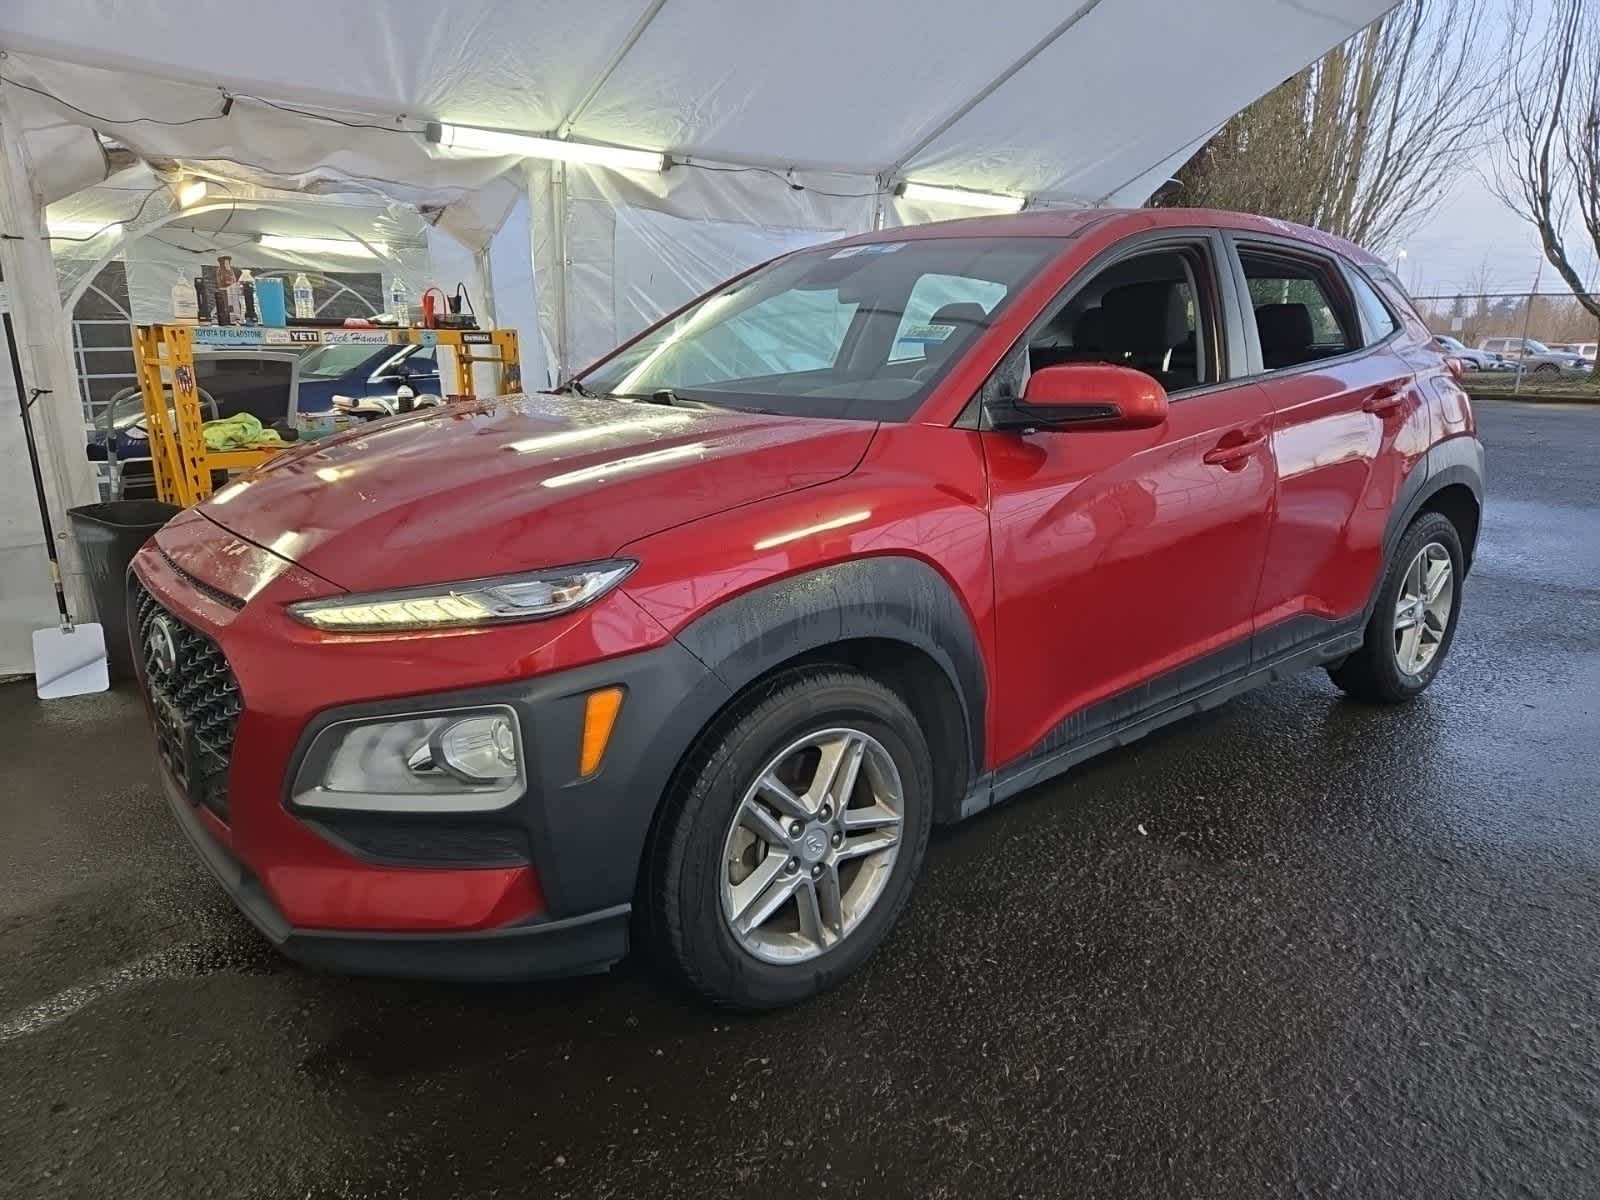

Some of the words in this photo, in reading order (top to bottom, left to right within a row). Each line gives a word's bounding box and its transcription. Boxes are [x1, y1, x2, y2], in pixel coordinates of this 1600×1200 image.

[195, 328, 218, 337] TOYOTA
[219, 329, 226, 338] OF
[228, 329, 263, 338] GLADSTONE
[291, 332, 318, 341] YETI
[324, 332, 349, 343] Dick
[350, 332, 389, 344] Hannah
